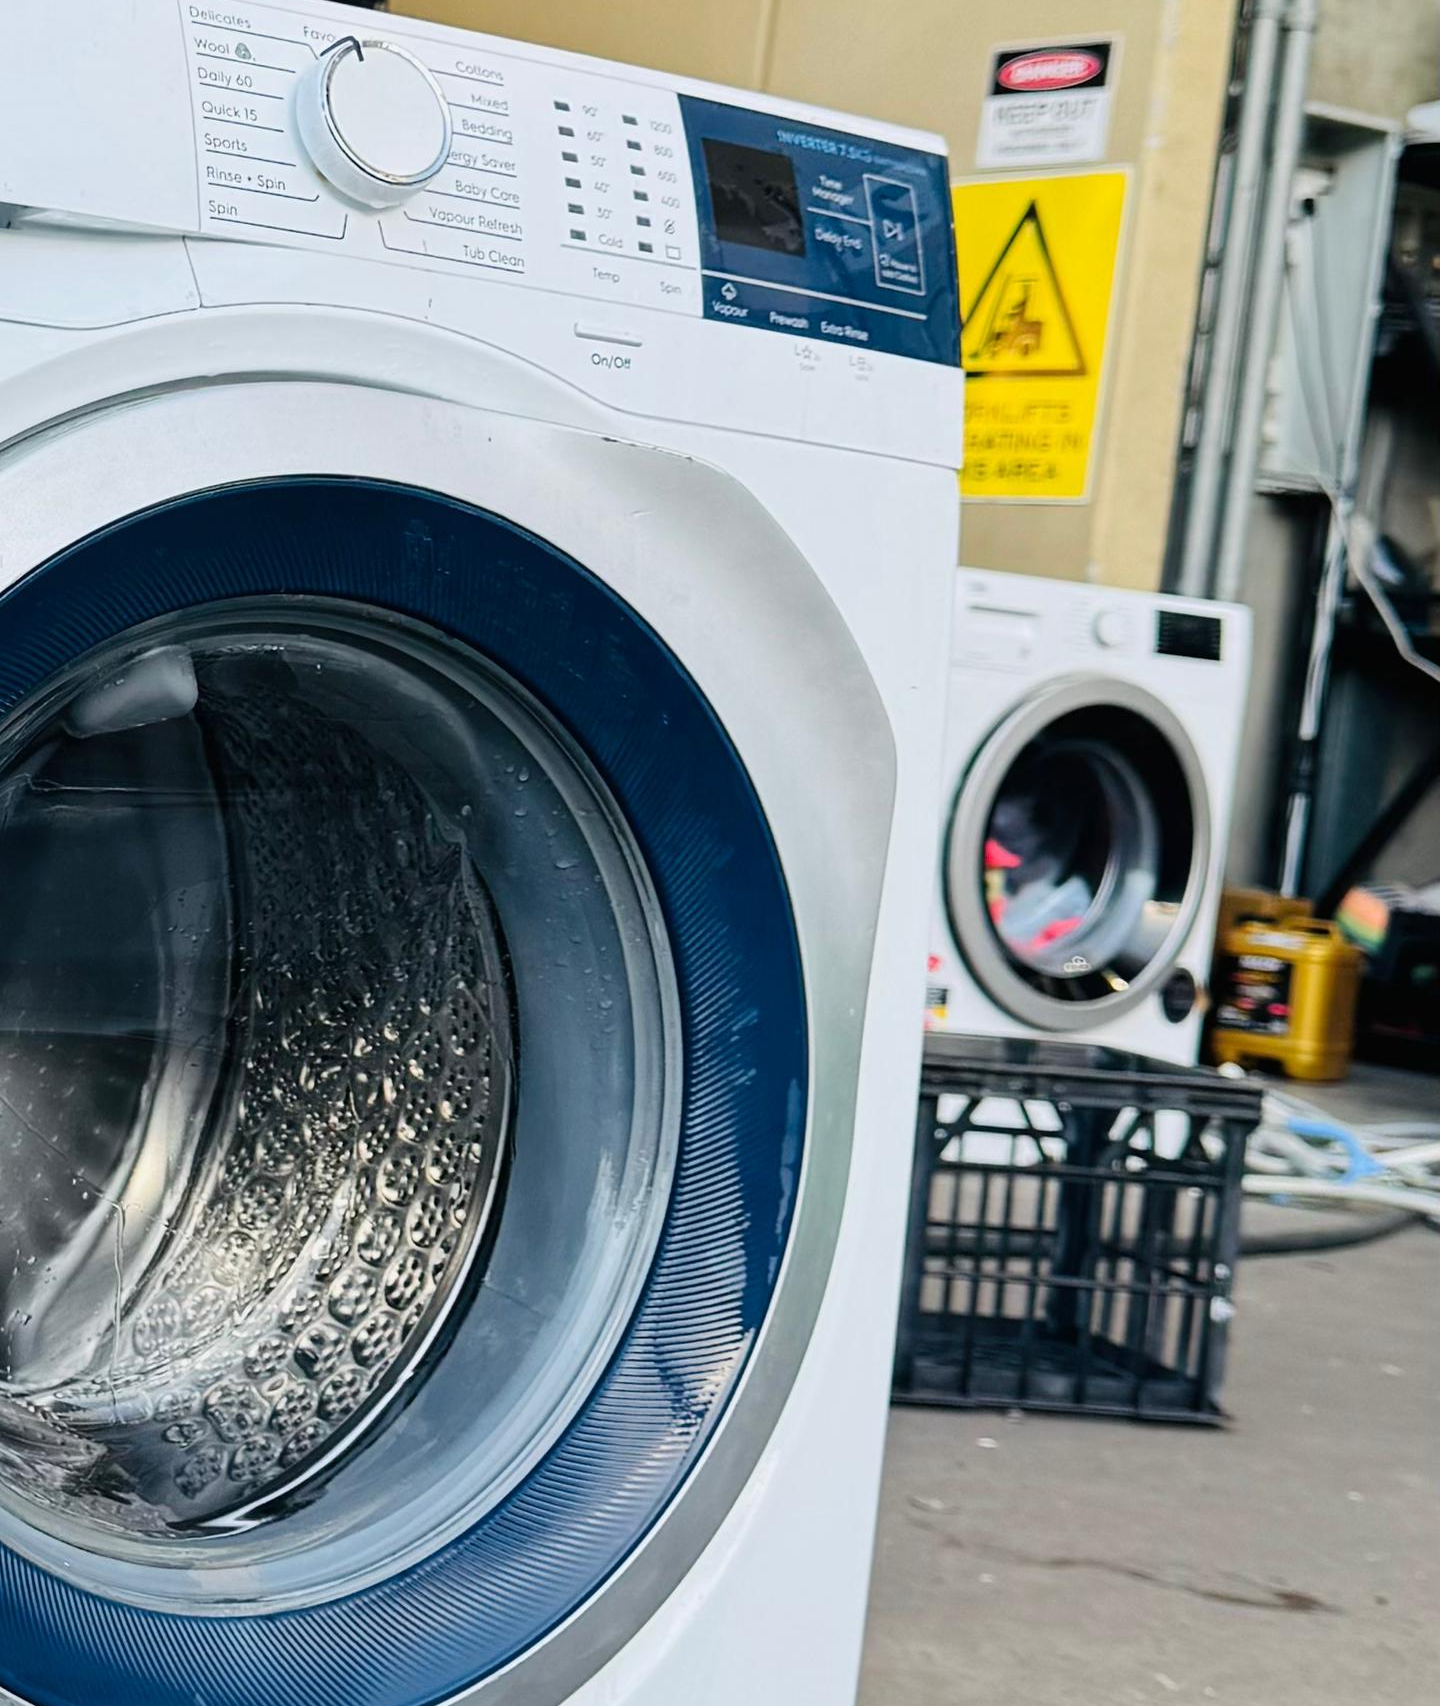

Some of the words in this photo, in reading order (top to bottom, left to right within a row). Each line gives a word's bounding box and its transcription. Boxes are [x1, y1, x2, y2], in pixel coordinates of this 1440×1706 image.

[189, 6, 251, 28] Delicates
[193, 37, 230, 54] Wool
[198, 67, 231, 86] Daily
[236, 74, 252, 88] 60
[455, 61, 504, 81] Cottons
[201, 100, 241, 119] Quick
[245, 108, 258, 122] 15
[471, 93, 509, 111] Mixed
[462, 118, 513, 142] Bedding
[204, 133, 248, 152] Sports
[447, 151, 478, 167] ergy
[481, 153, 517, 172] Saver
[206, 166, 242, 183] Rinse
[257, 174, 286, 191] Spin
[455, 179, 487, 199] Baby
[490, 187, 520, 204] Care
[209, 200, 238, 216] Spin
[429, 205, 475, 226] Vapour
[478, 215, 523, 235] Refresh
[598, 234, 624, 249] Cold
[463, 244, 485, 260] Tub
[488, 250, 525, 268] Clean
[593, 267, 621, 284] Temp
[660, 281, 683, 295] Spin
[712, 300, 750, 318] Vapour
[591, 353, 631, 370] On/Off
